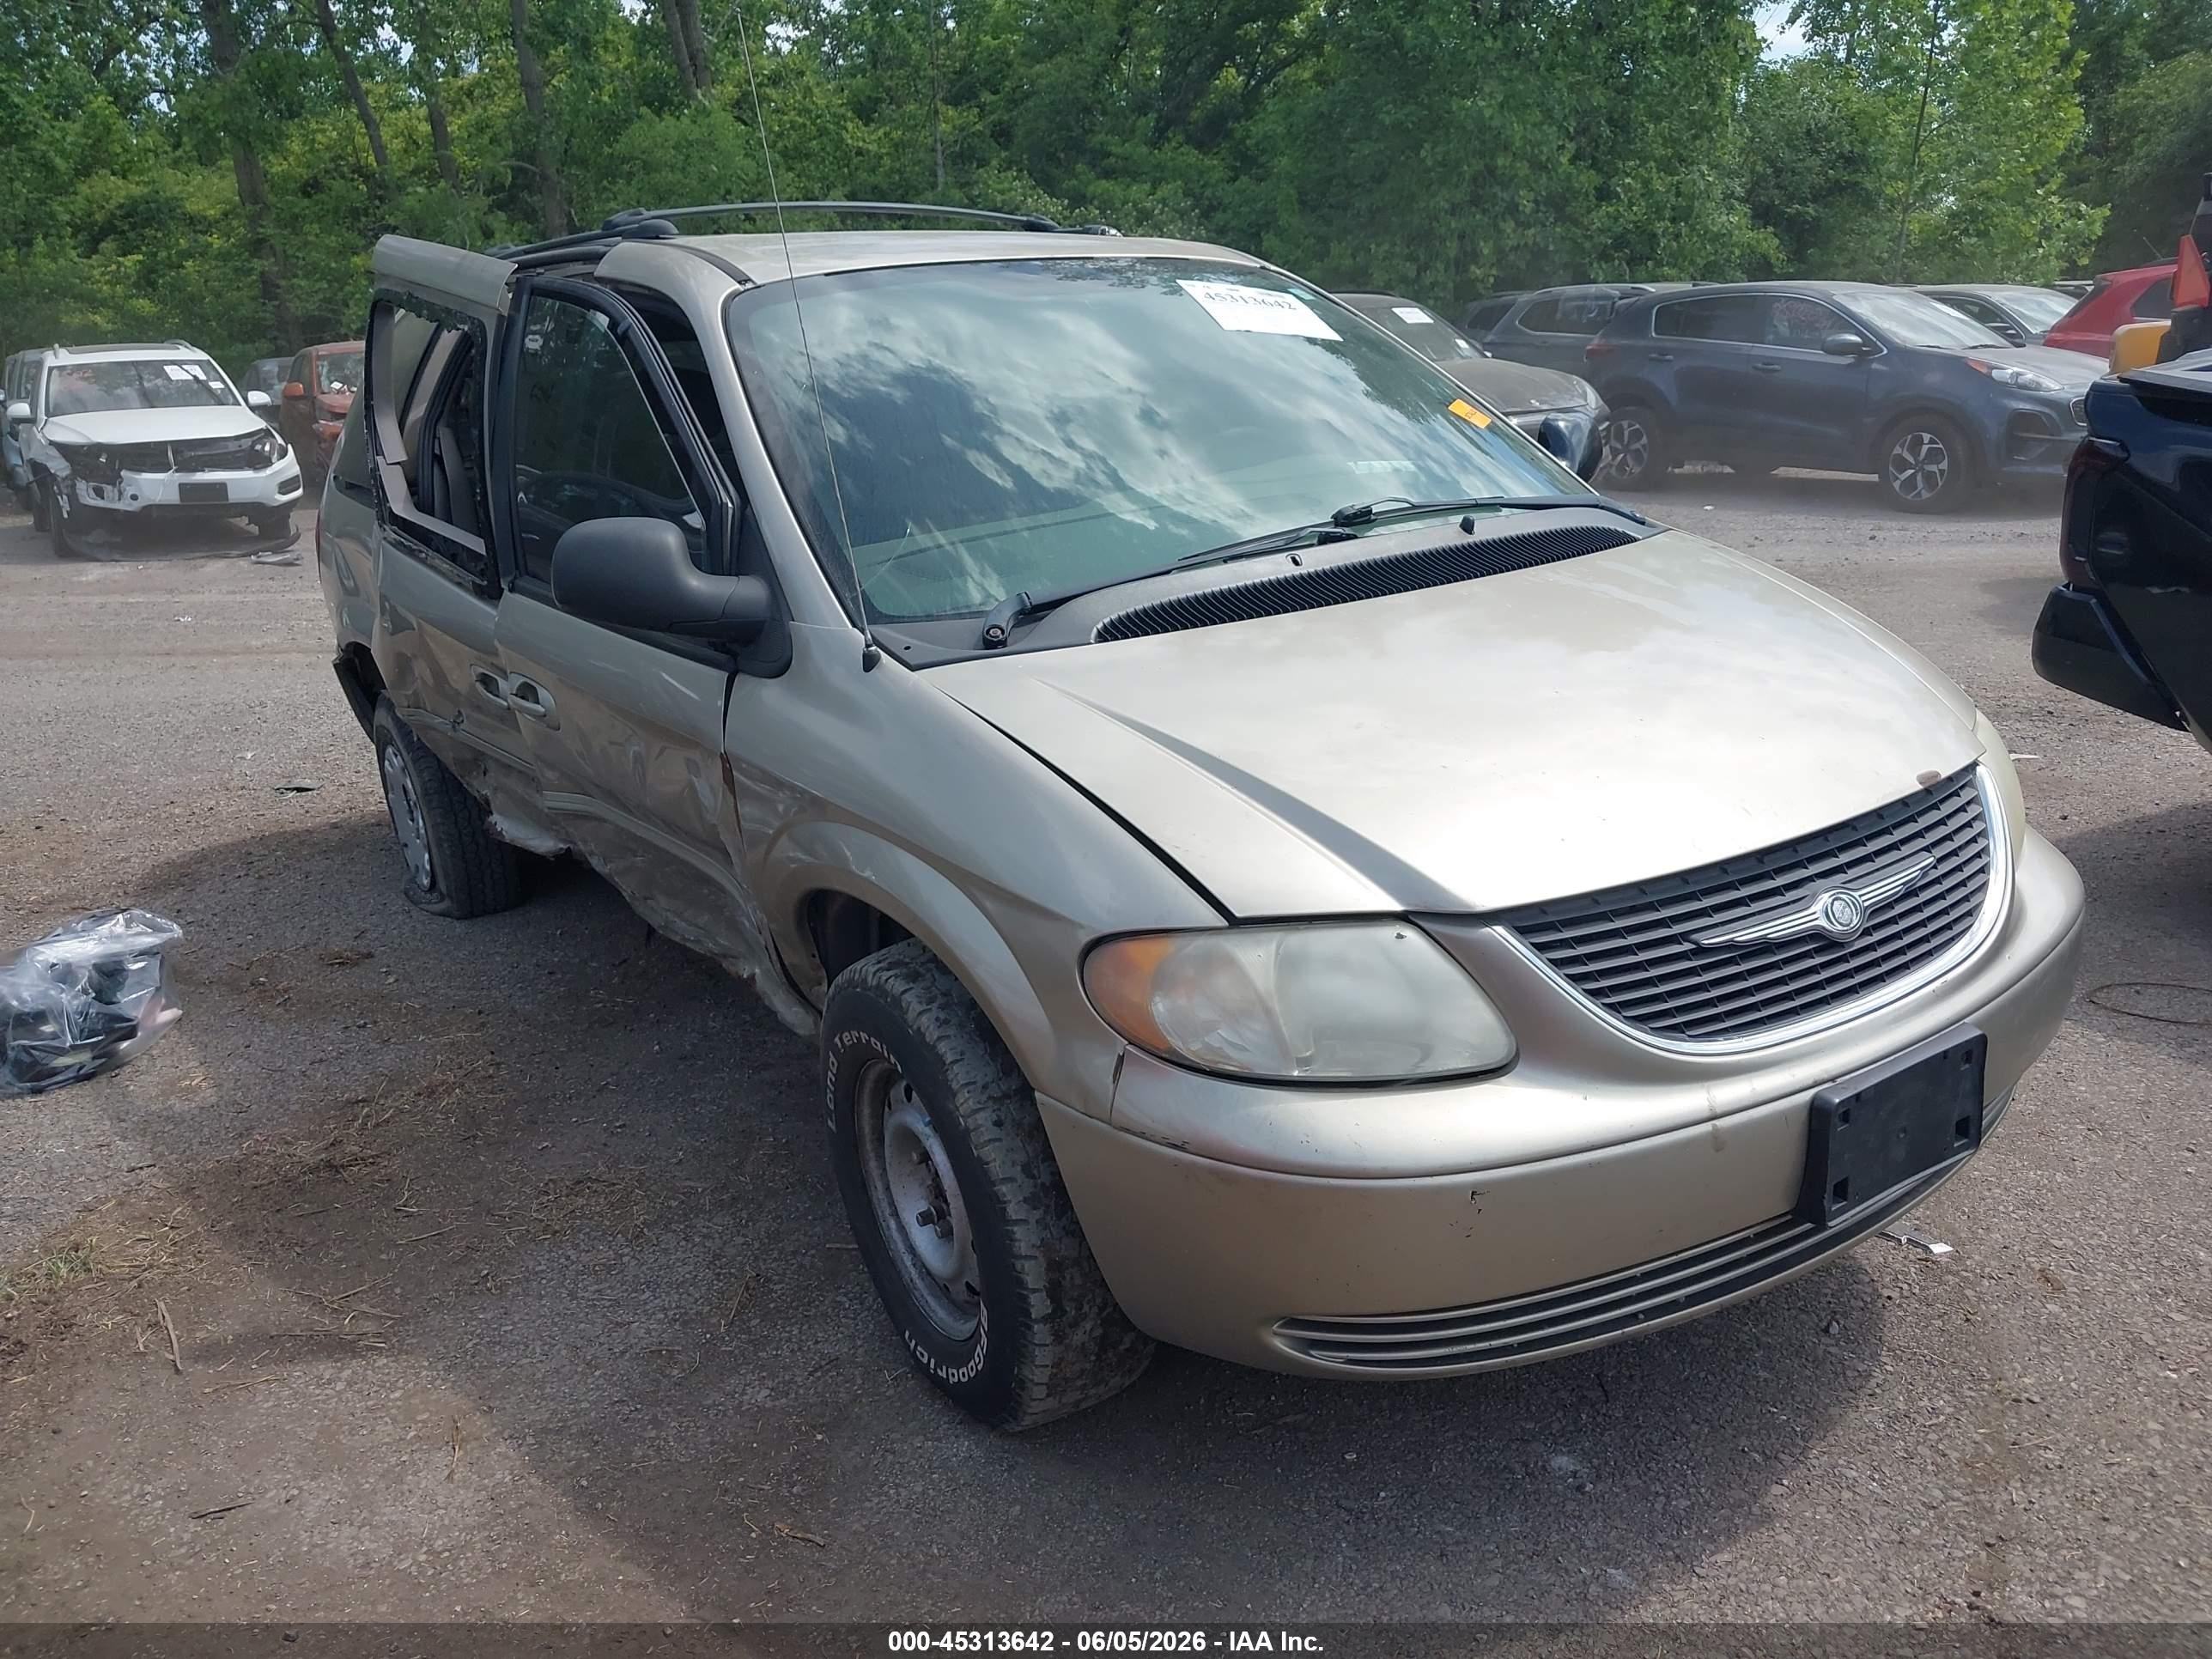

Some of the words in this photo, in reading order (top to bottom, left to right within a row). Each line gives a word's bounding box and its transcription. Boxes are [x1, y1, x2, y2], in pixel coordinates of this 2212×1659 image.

[1203, 291, 1297, 311] 45313642
[833, 1030, 902, 1074] Terrain
[904, 1297, 988, 1385] BFGoodrich
